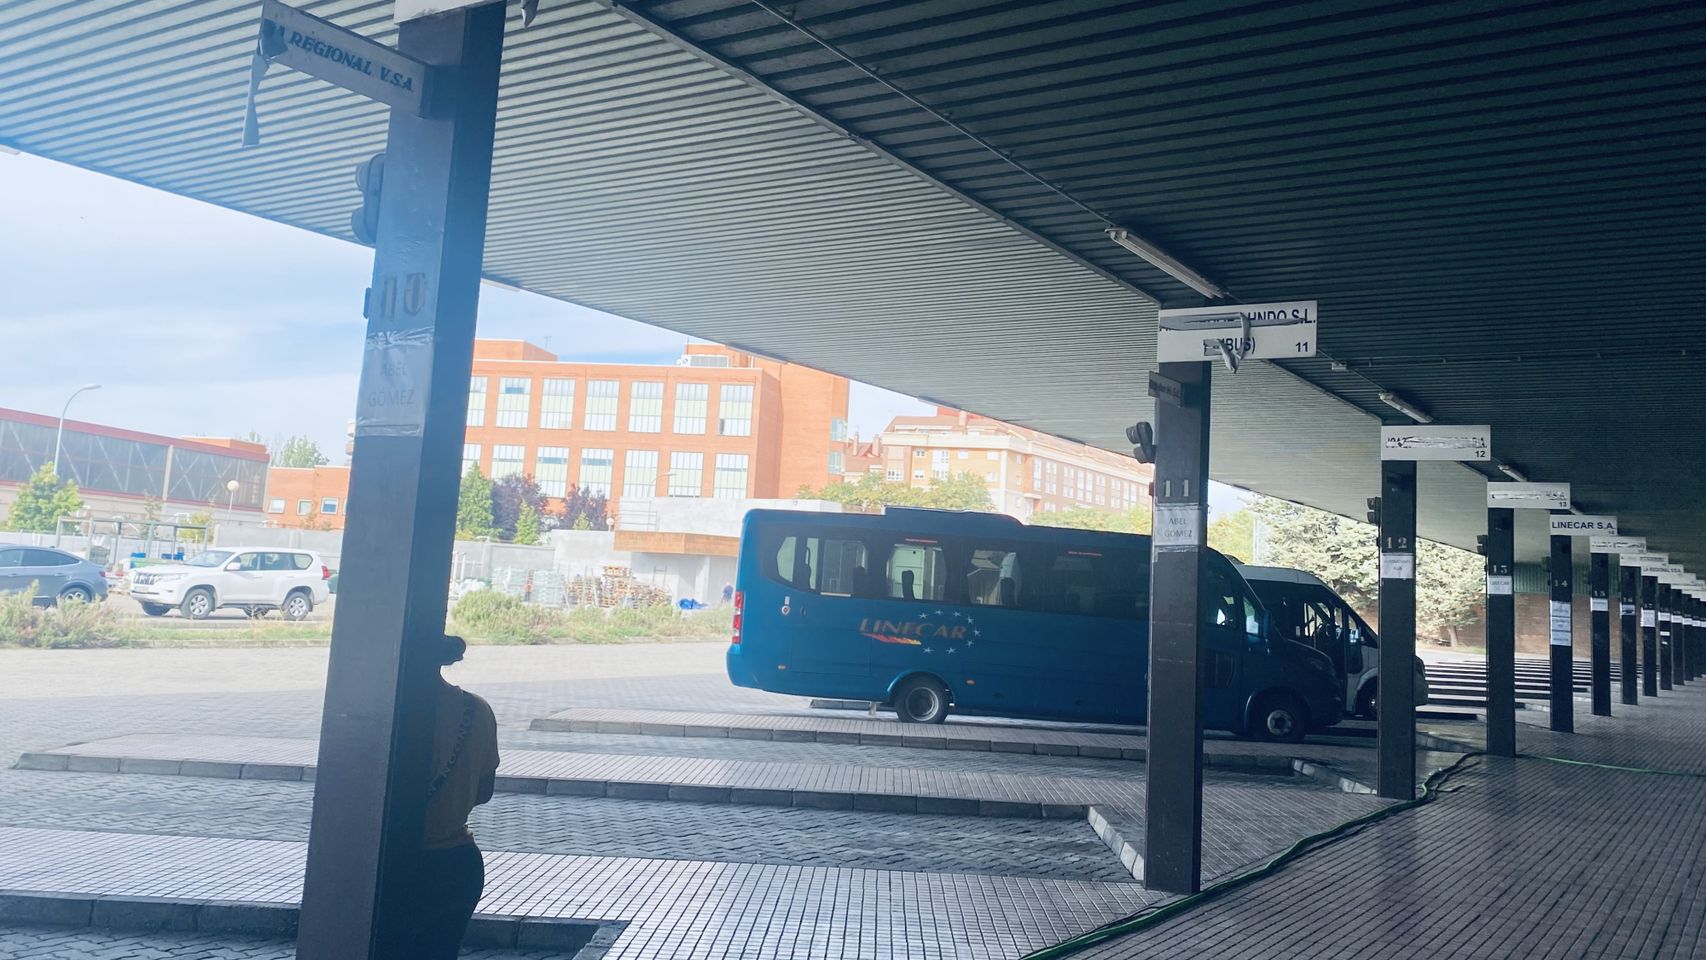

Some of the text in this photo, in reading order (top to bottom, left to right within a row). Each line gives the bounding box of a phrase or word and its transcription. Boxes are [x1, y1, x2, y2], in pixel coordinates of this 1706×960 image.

[289, 31, 372, 76] REGIONAL
[1295, 342, 1308, 352] 11
[1475, 450, 1486, 458] 12
[1165, 479, 1189, 497] 11
[1551, 521, 1594, 530] LINECAR
[1387, 536, 1408, 549] 12
[859, 618, 968, 640] LINECAR
